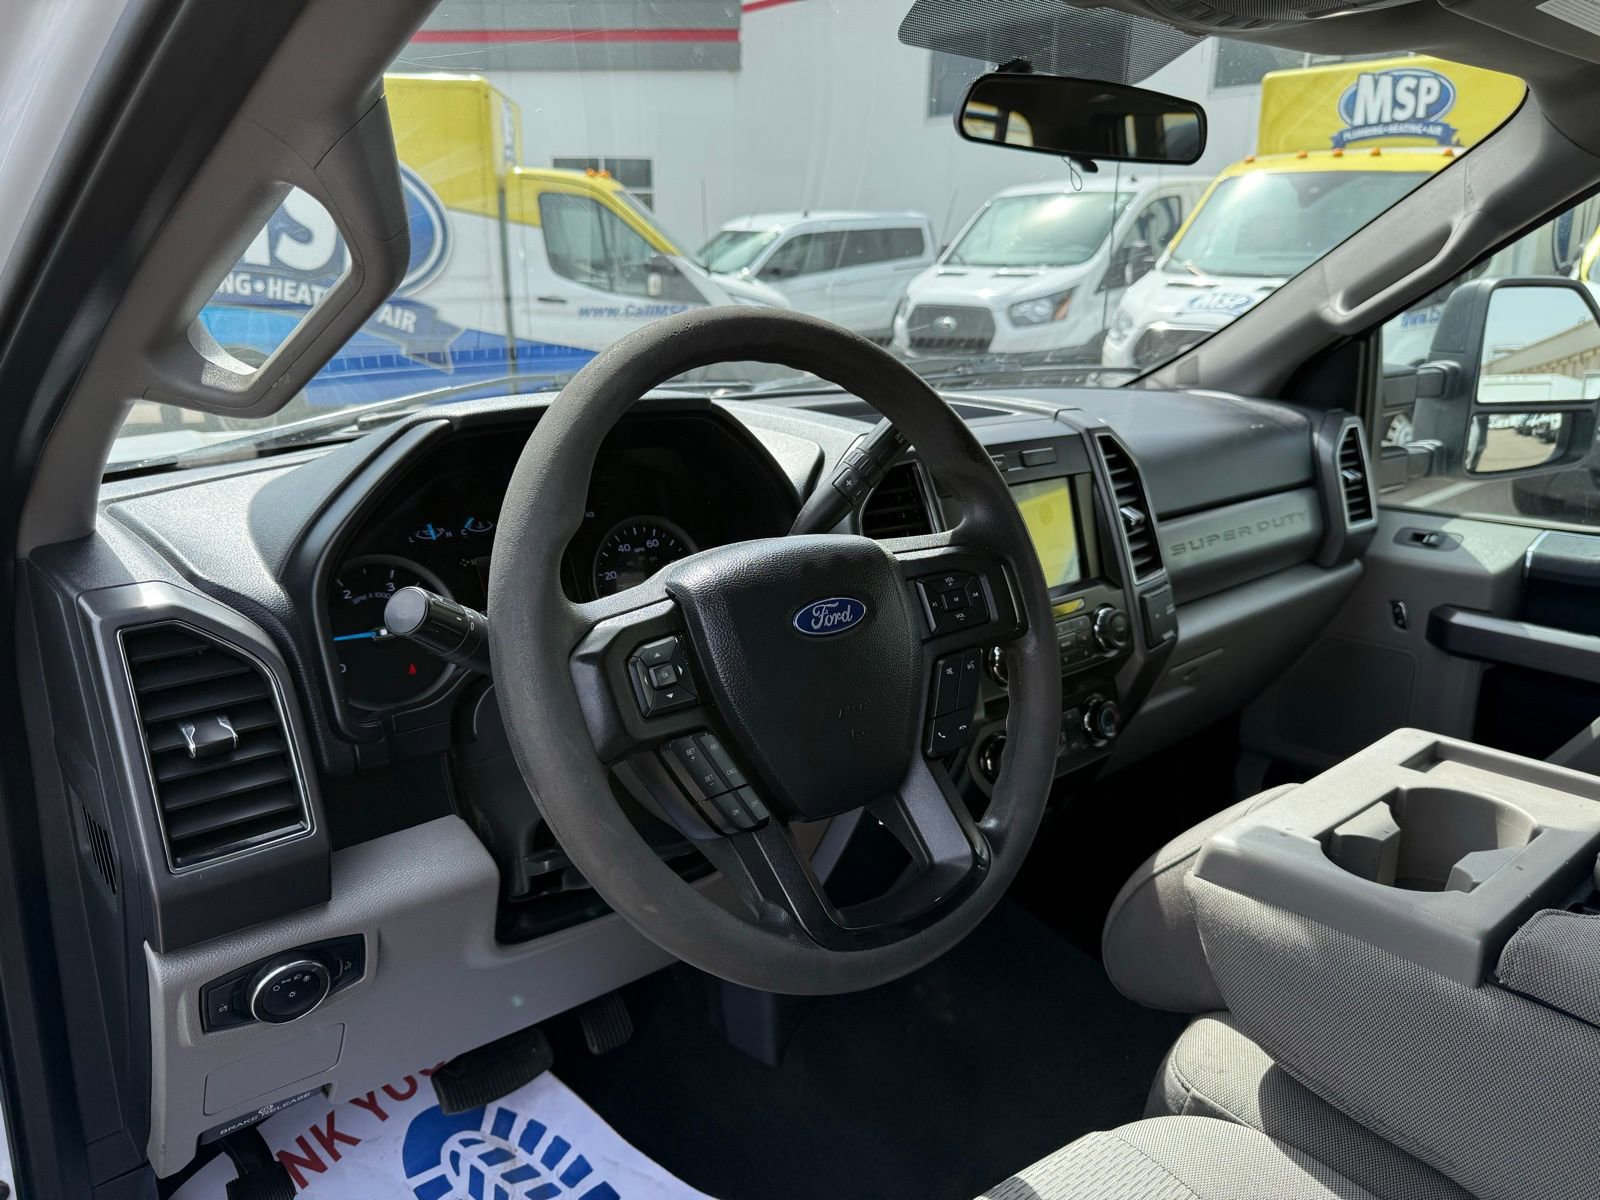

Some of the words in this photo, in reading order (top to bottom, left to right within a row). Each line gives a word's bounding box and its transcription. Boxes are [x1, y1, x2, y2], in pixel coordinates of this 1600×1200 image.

[1352, 73, 1441, 127] MSP
[375, 303, 417, 334] AIR
[1169, 525, 1252, 557] SUPER
[1256, 510, 1306, 532] DUTY
[618, 543, 631, 552] 40
[646, 538, 660, 549] 60
[604, 570, 618, 580] 20
[386, 582, 396, 592] 3
[343, 589, 353, 600] 2
[811, 601, 853, 630] Ford
[686, 747, 696, 756] SET
[704, 774, 714, 783] SET
[219, 1114, 258, 1135] BRAKE
[261, 1092, 311, 1118] RELEASE
